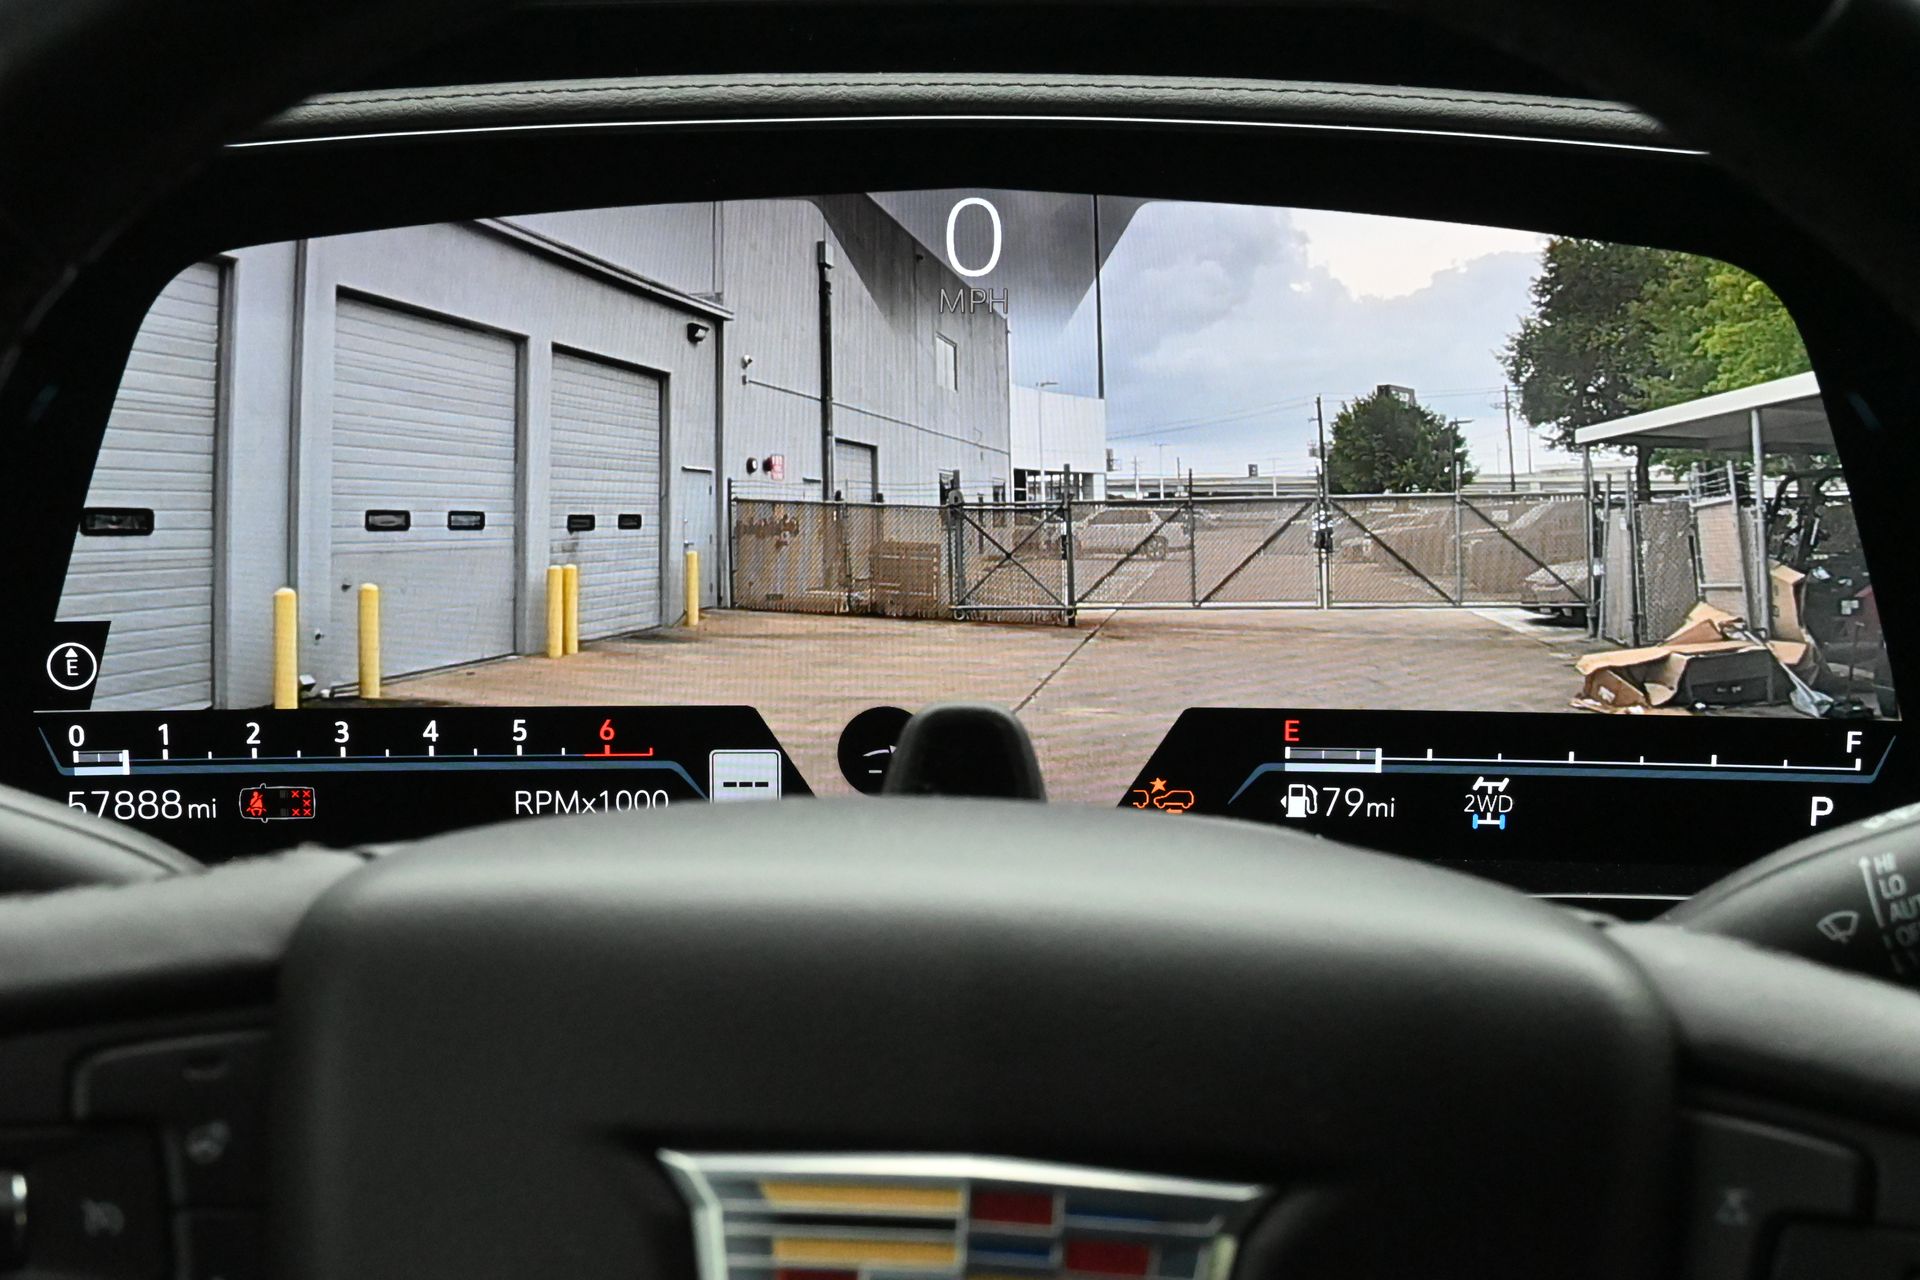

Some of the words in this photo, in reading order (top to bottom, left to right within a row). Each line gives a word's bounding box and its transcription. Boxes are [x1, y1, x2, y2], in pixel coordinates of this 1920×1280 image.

[946, 197, 1002, 277] 0
[939, 288, 1008, 314] MPH
[67, 659, 79, 676] E
[68, 725, 85, 747] 0
[158, 723, 169, 745] 1
[245, 722, 262, 744] 2
[334, 721, 350, 743] 3
[422, 720, 439, 742] 4
[512, 719, 527, 741] 5
[599, 719, 615, 741] 6
[1284, 720, 1300, 742] E
[1846, 731, 1863, 753] F
[1463, 795, 1513, 813] 2WD
[1810, 796, 1834, 826] P
[1879, 873, 1906, 899] LO
